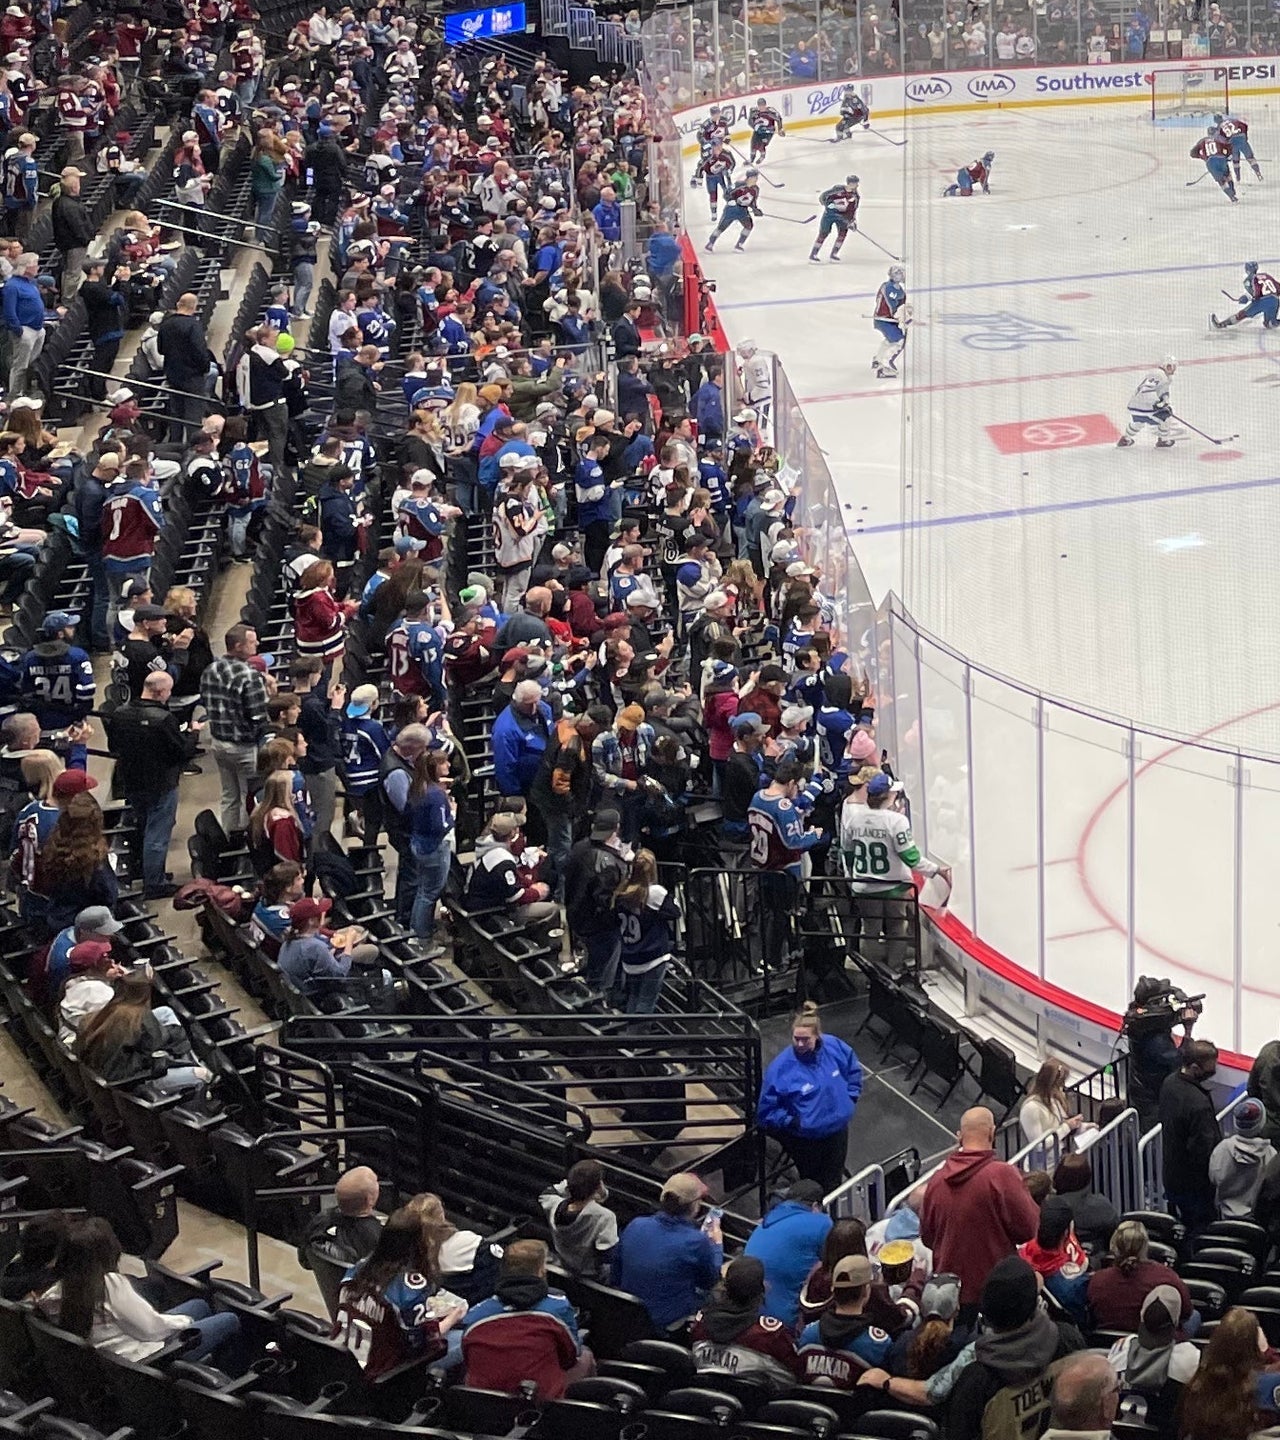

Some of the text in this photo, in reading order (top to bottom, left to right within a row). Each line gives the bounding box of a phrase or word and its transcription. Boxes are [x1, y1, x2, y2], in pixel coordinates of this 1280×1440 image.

[1035, 71, 1142, 92] Southwest
[1213, 64, 1276, 82] PEPSI
[911, 82, 945, 97] IMA
[974, 78, 1006, 93] IMA
[1260, 278, 1276, 293] 20
[806, 1355, 851, 1381] MAKAR
[1012, 1376, 1054, 1416] TOEW
